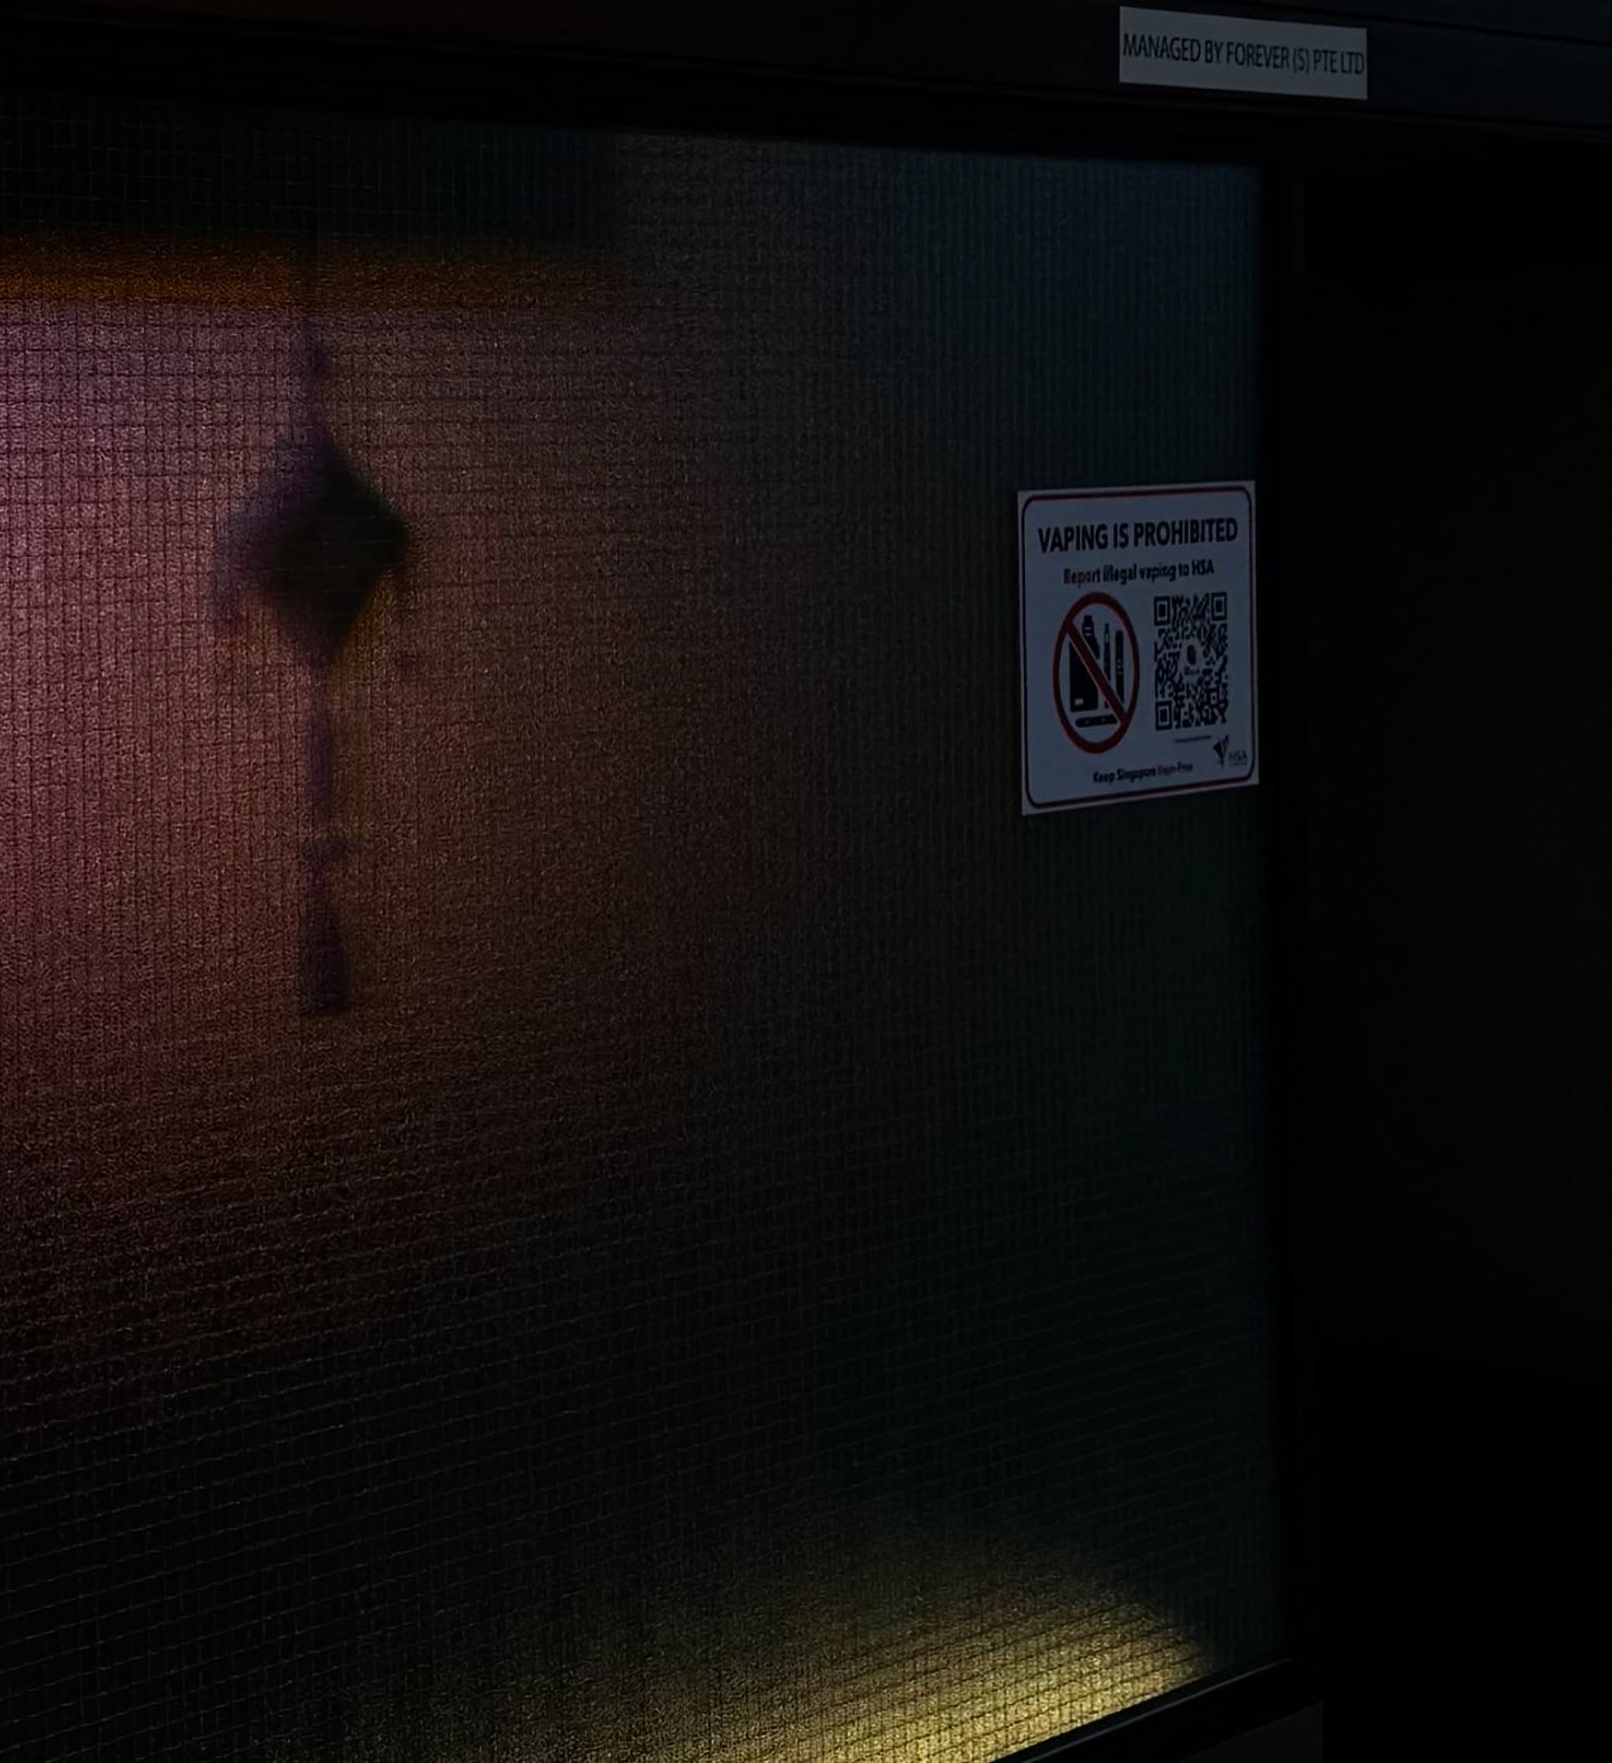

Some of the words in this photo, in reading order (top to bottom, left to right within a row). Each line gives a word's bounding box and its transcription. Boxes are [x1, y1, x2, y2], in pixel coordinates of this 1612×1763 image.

[1123, 33, 1201, 63] MANAGED
[1204, 39, 1224, 64] BY
[1226, 41, 1290, 70] FOREVER
[1293, 47, 1309, 75] (S)
[1313, 49, 1337, 74] PTE
[1340, 51, 1365, 75] LTD
[1038, 523, 1108, 554] VAPING
[1113, 523, 1129, 549] IS
[1134, 517, 1238, 547] PROHIBITED
[1063, 568, 1100, 587] Report
[1103, 563, 1137, 585] illegal
[1139, 562, 1176, 583] vaping
[1178, 562, 1189, 577] to
[1191, 559, 1214, 576] HSA
